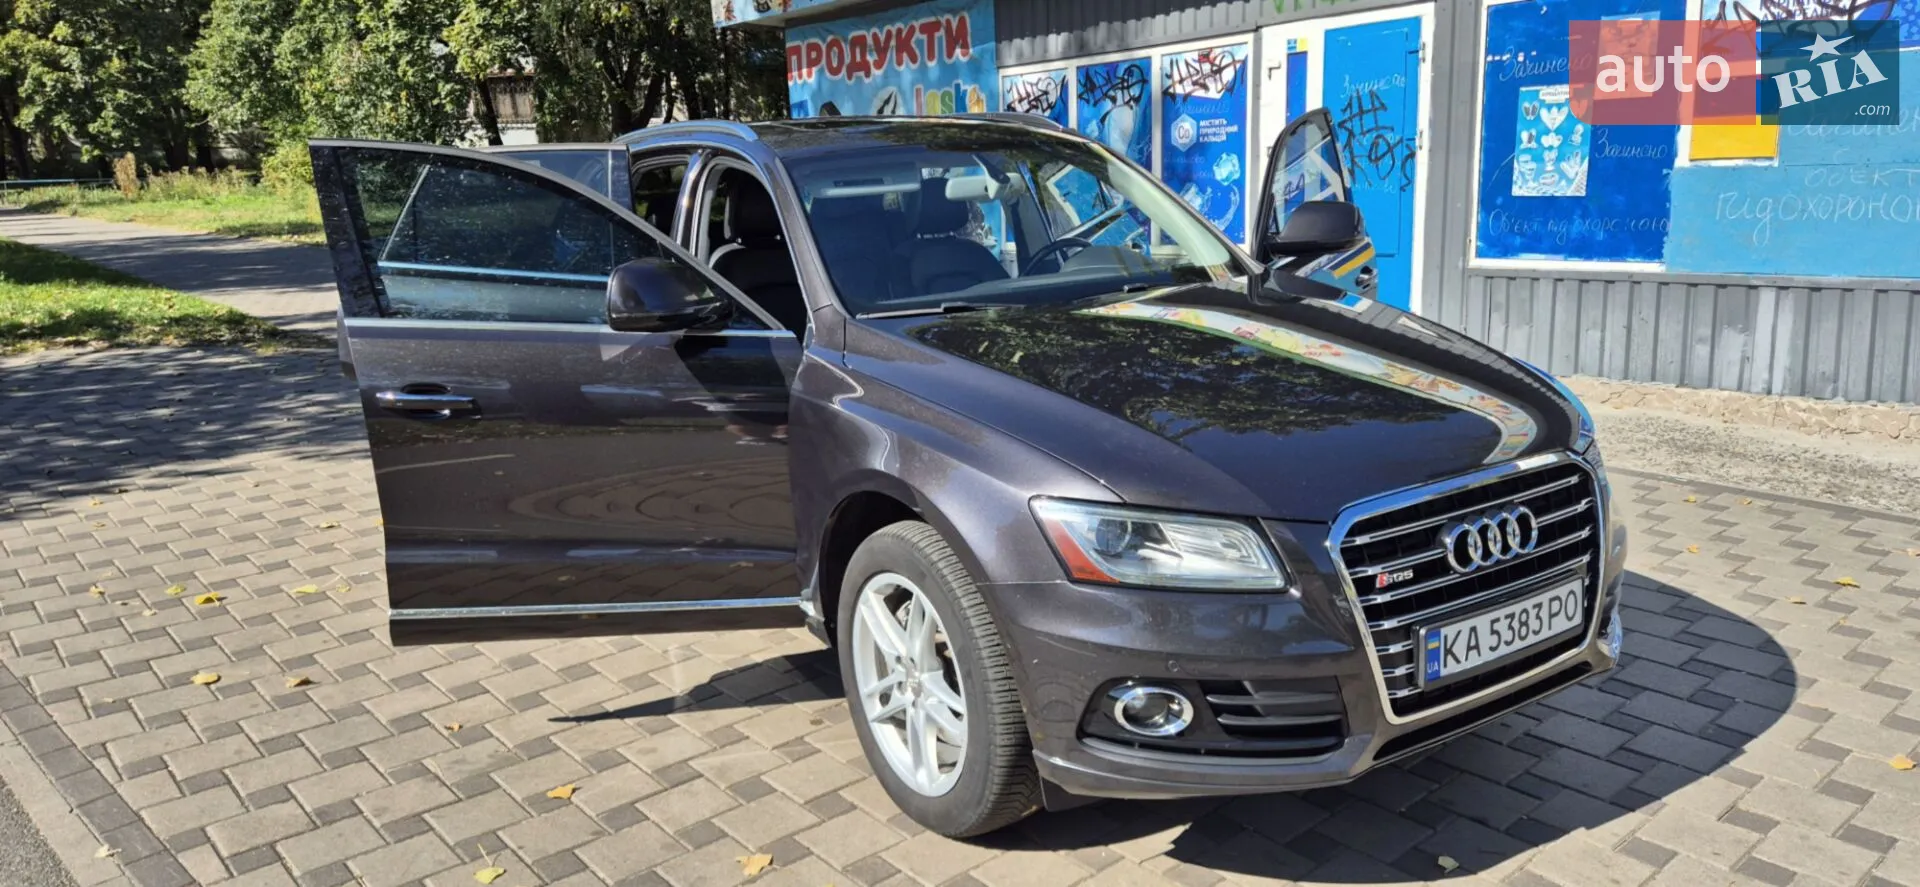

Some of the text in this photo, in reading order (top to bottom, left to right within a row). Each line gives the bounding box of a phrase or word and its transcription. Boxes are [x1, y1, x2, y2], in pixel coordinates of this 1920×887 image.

[786, 14, 971, 82] ПРОДУКТИ
[1443, 589, 1578, 669] KA 5383 PO
[1427, 662, 1440, 674] UA
